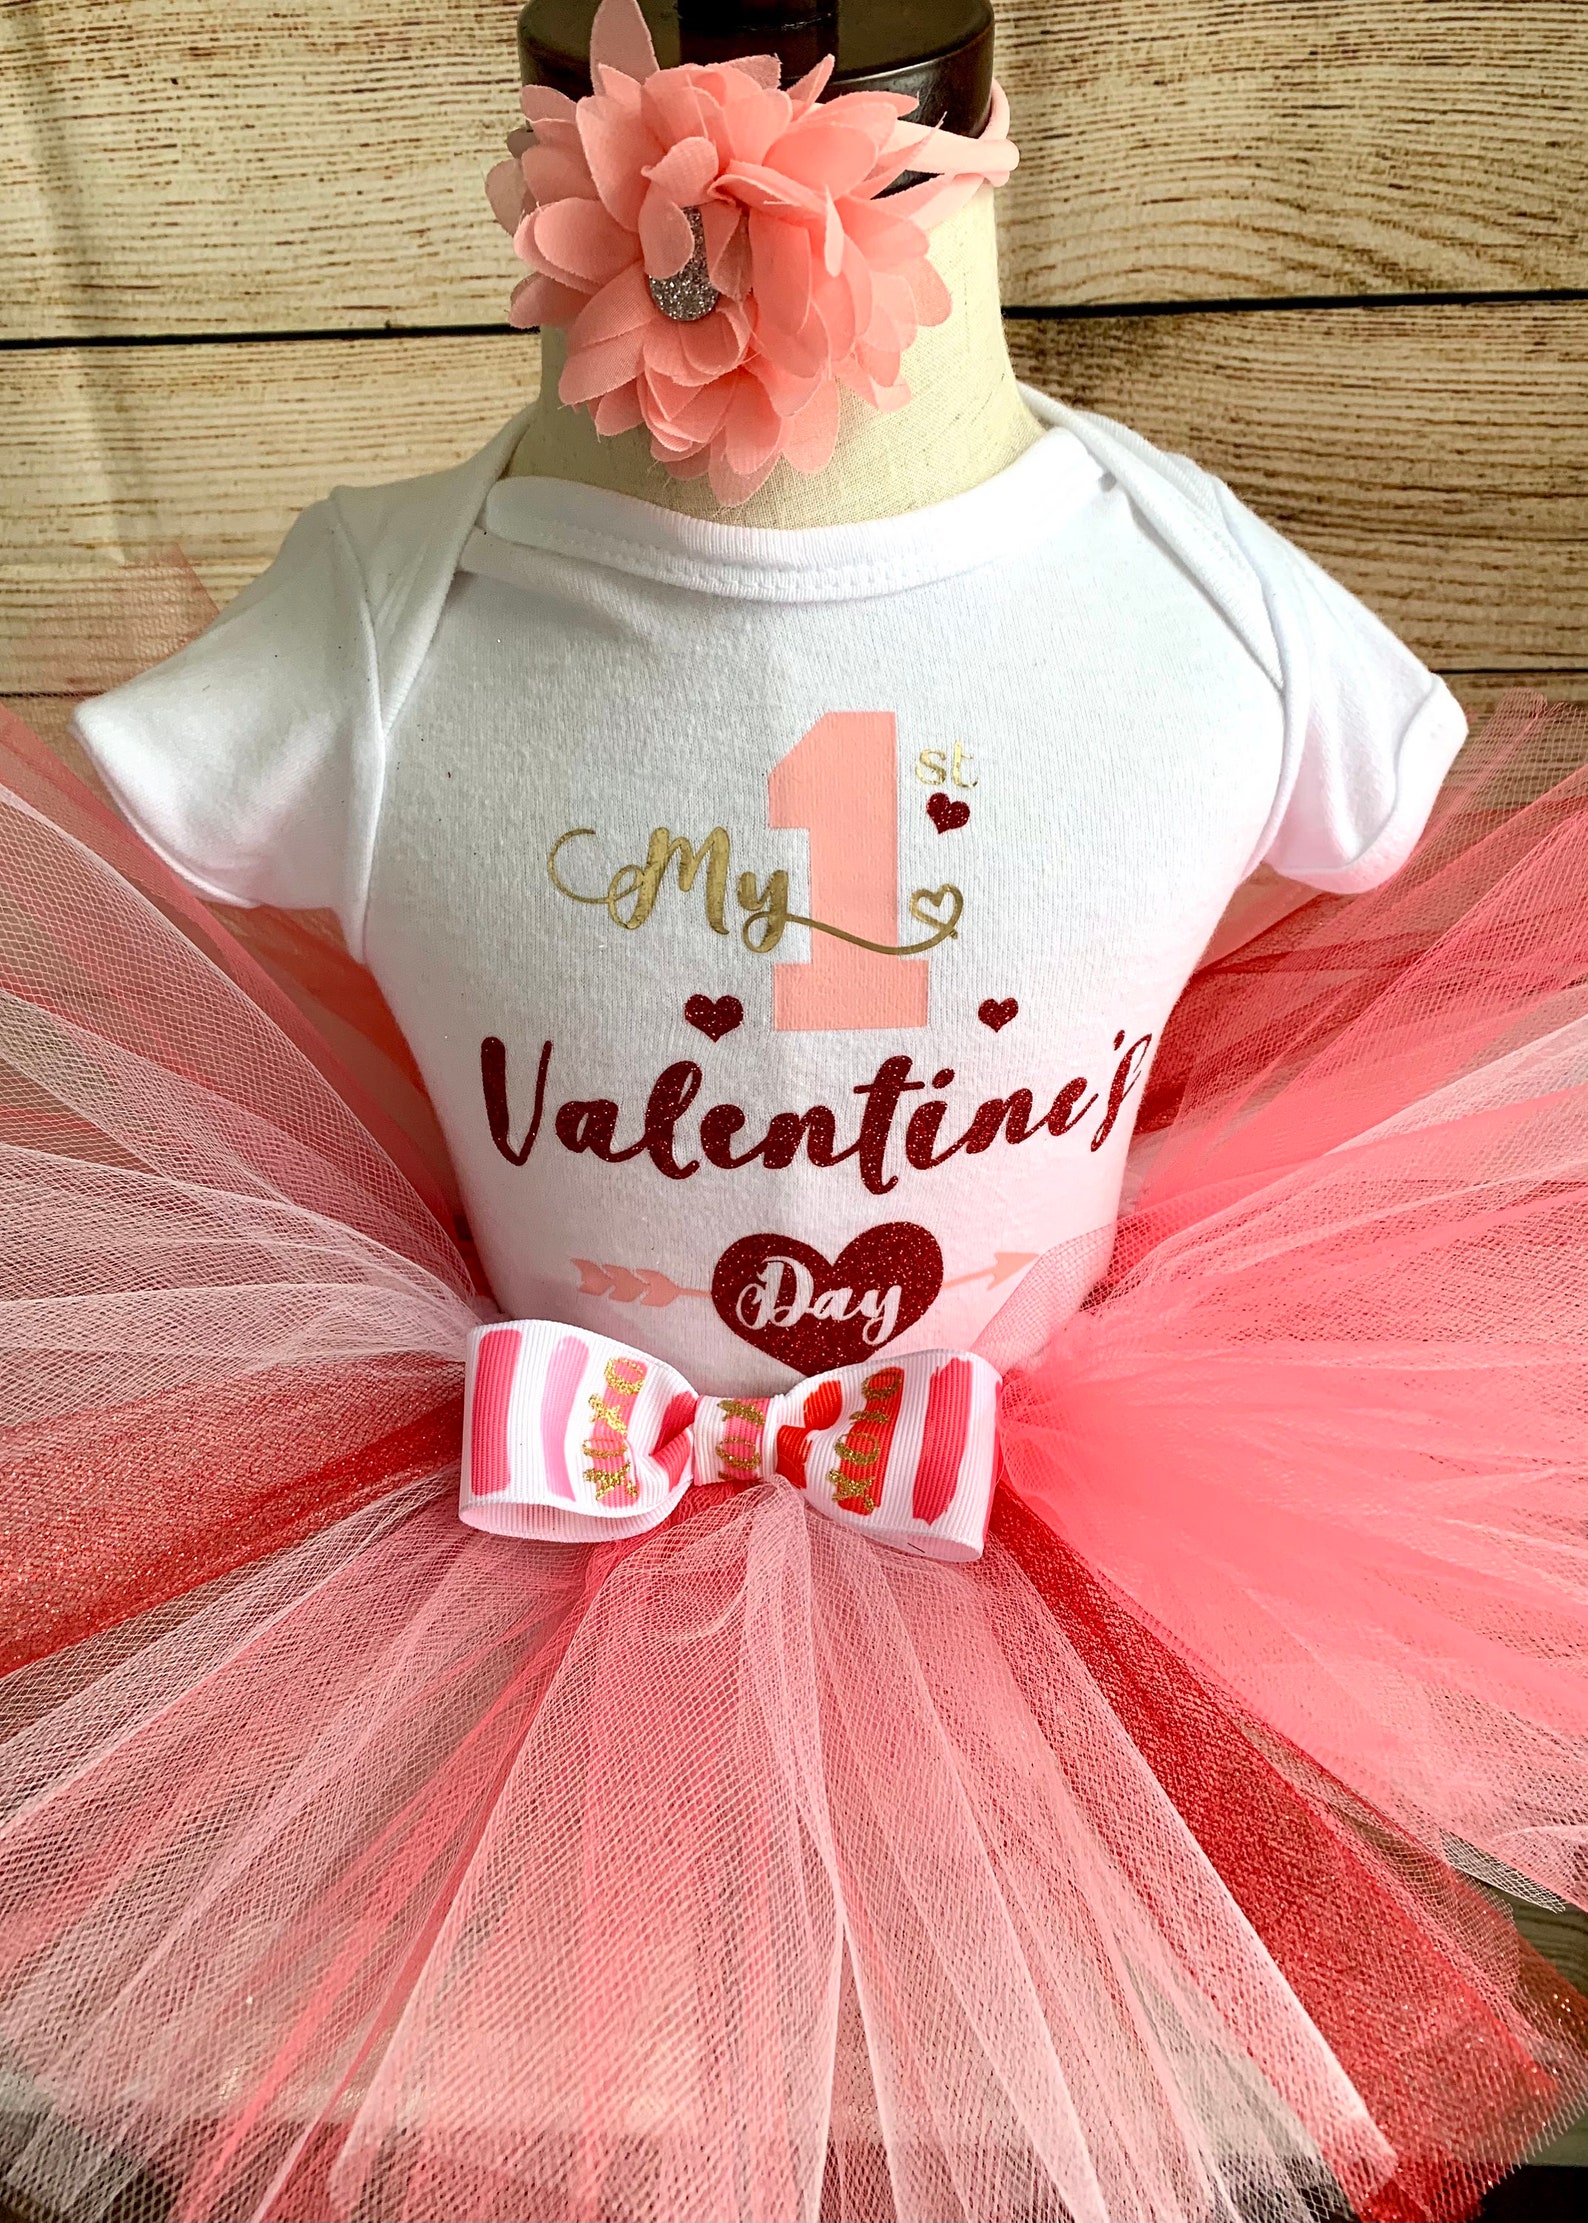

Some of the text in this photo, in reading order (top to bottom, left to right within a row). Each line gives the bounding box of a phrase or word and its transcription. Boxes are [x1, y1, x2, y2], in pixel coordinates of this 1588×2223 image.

[547, 826, 905, 955] My
[480, 1029, 1153, 1196] Valentine's
[735, 1255, 902, 1346] Day
